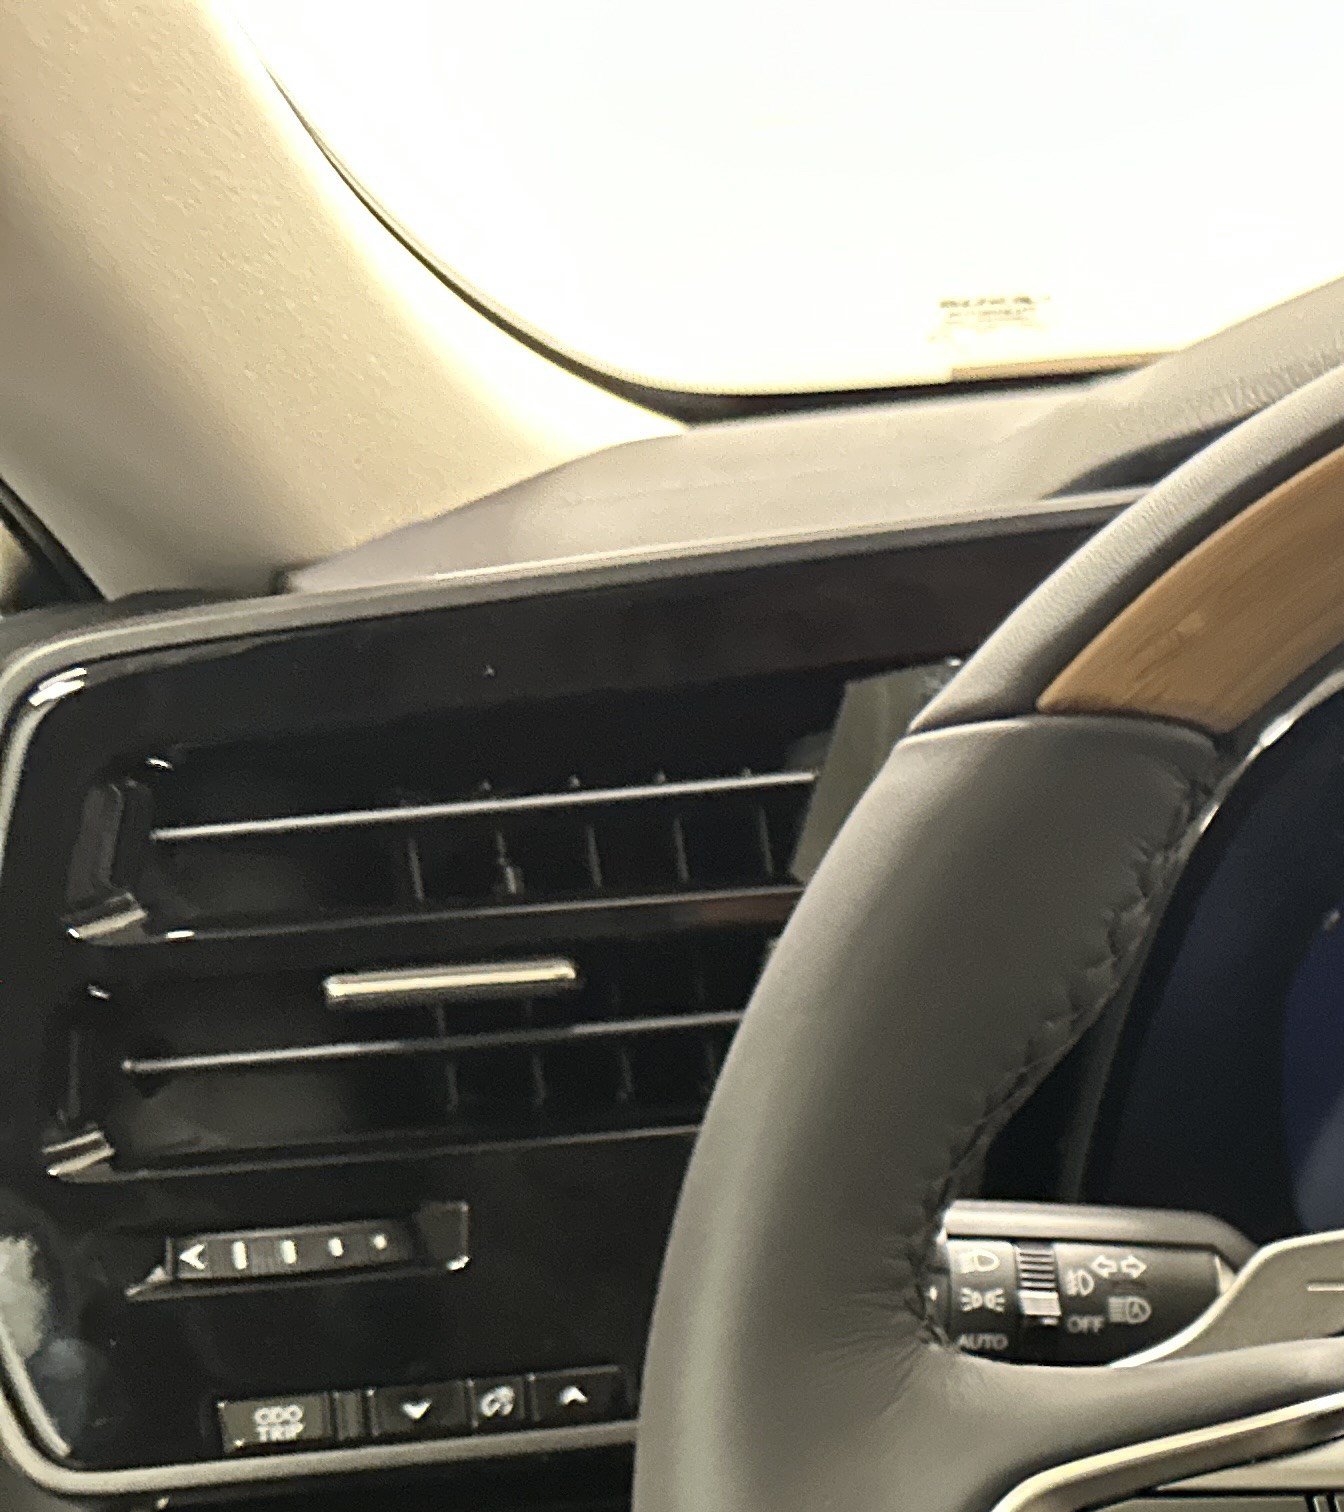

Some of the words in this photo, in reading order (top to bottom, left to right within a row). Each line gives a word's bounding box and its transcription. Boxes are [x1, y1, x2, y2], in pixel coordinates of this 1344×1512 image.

[1066, 1315, 1105, 1335] OFF
[958, 1332, 1009, 1351] AUTO
[252, 1404, 304, 1425] ODO
[256, 1421, 307, 1443] TRIP
